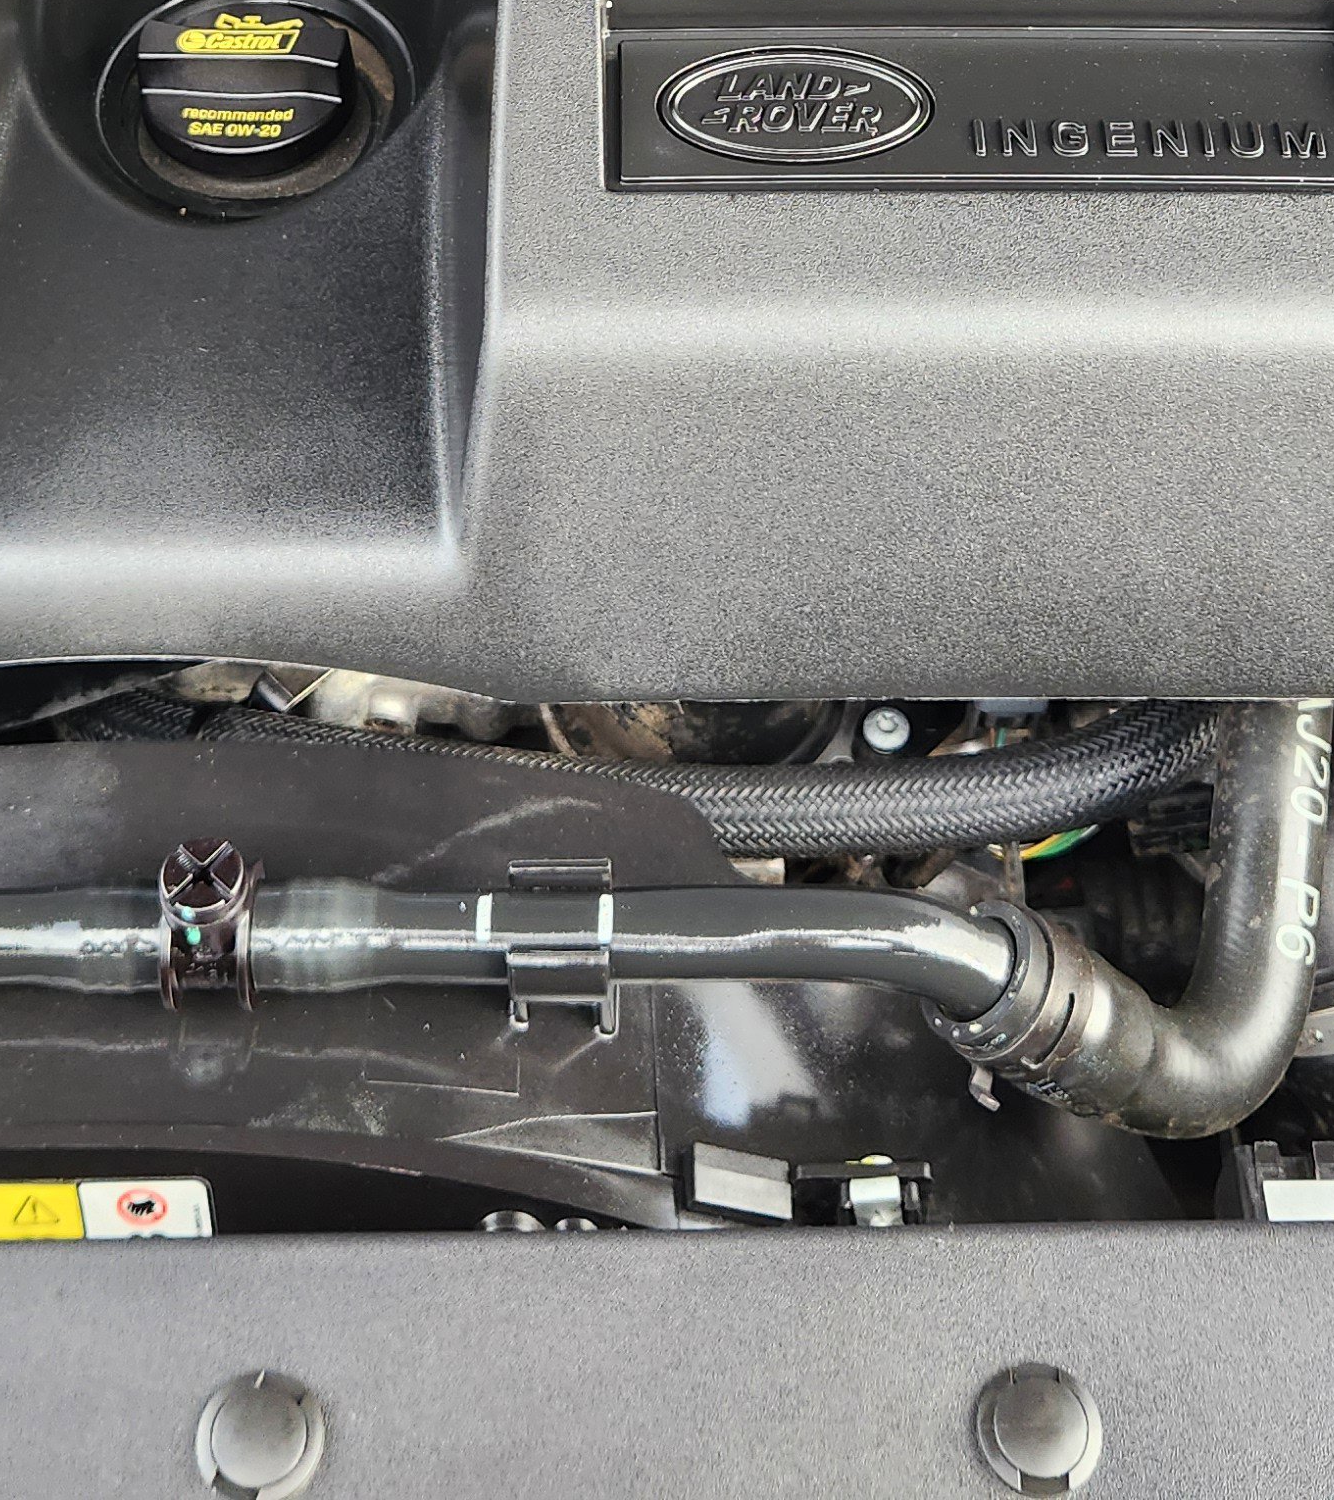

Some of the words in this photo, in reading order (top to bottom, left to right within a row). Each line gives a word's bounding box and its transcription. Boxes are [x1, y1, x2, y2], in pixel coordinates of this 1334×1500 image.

[204, 32, 283, 51] Castrol
[717, 72, 842, 102] LAND
[181, 106, 295, 123] recommended
[727, 100, 884, 138] ROVER
[187, 121, 224, 137] SAE
[225, 123, 283, 138] 0W-20
[971, 117, 1328, 159] INGENIUM
